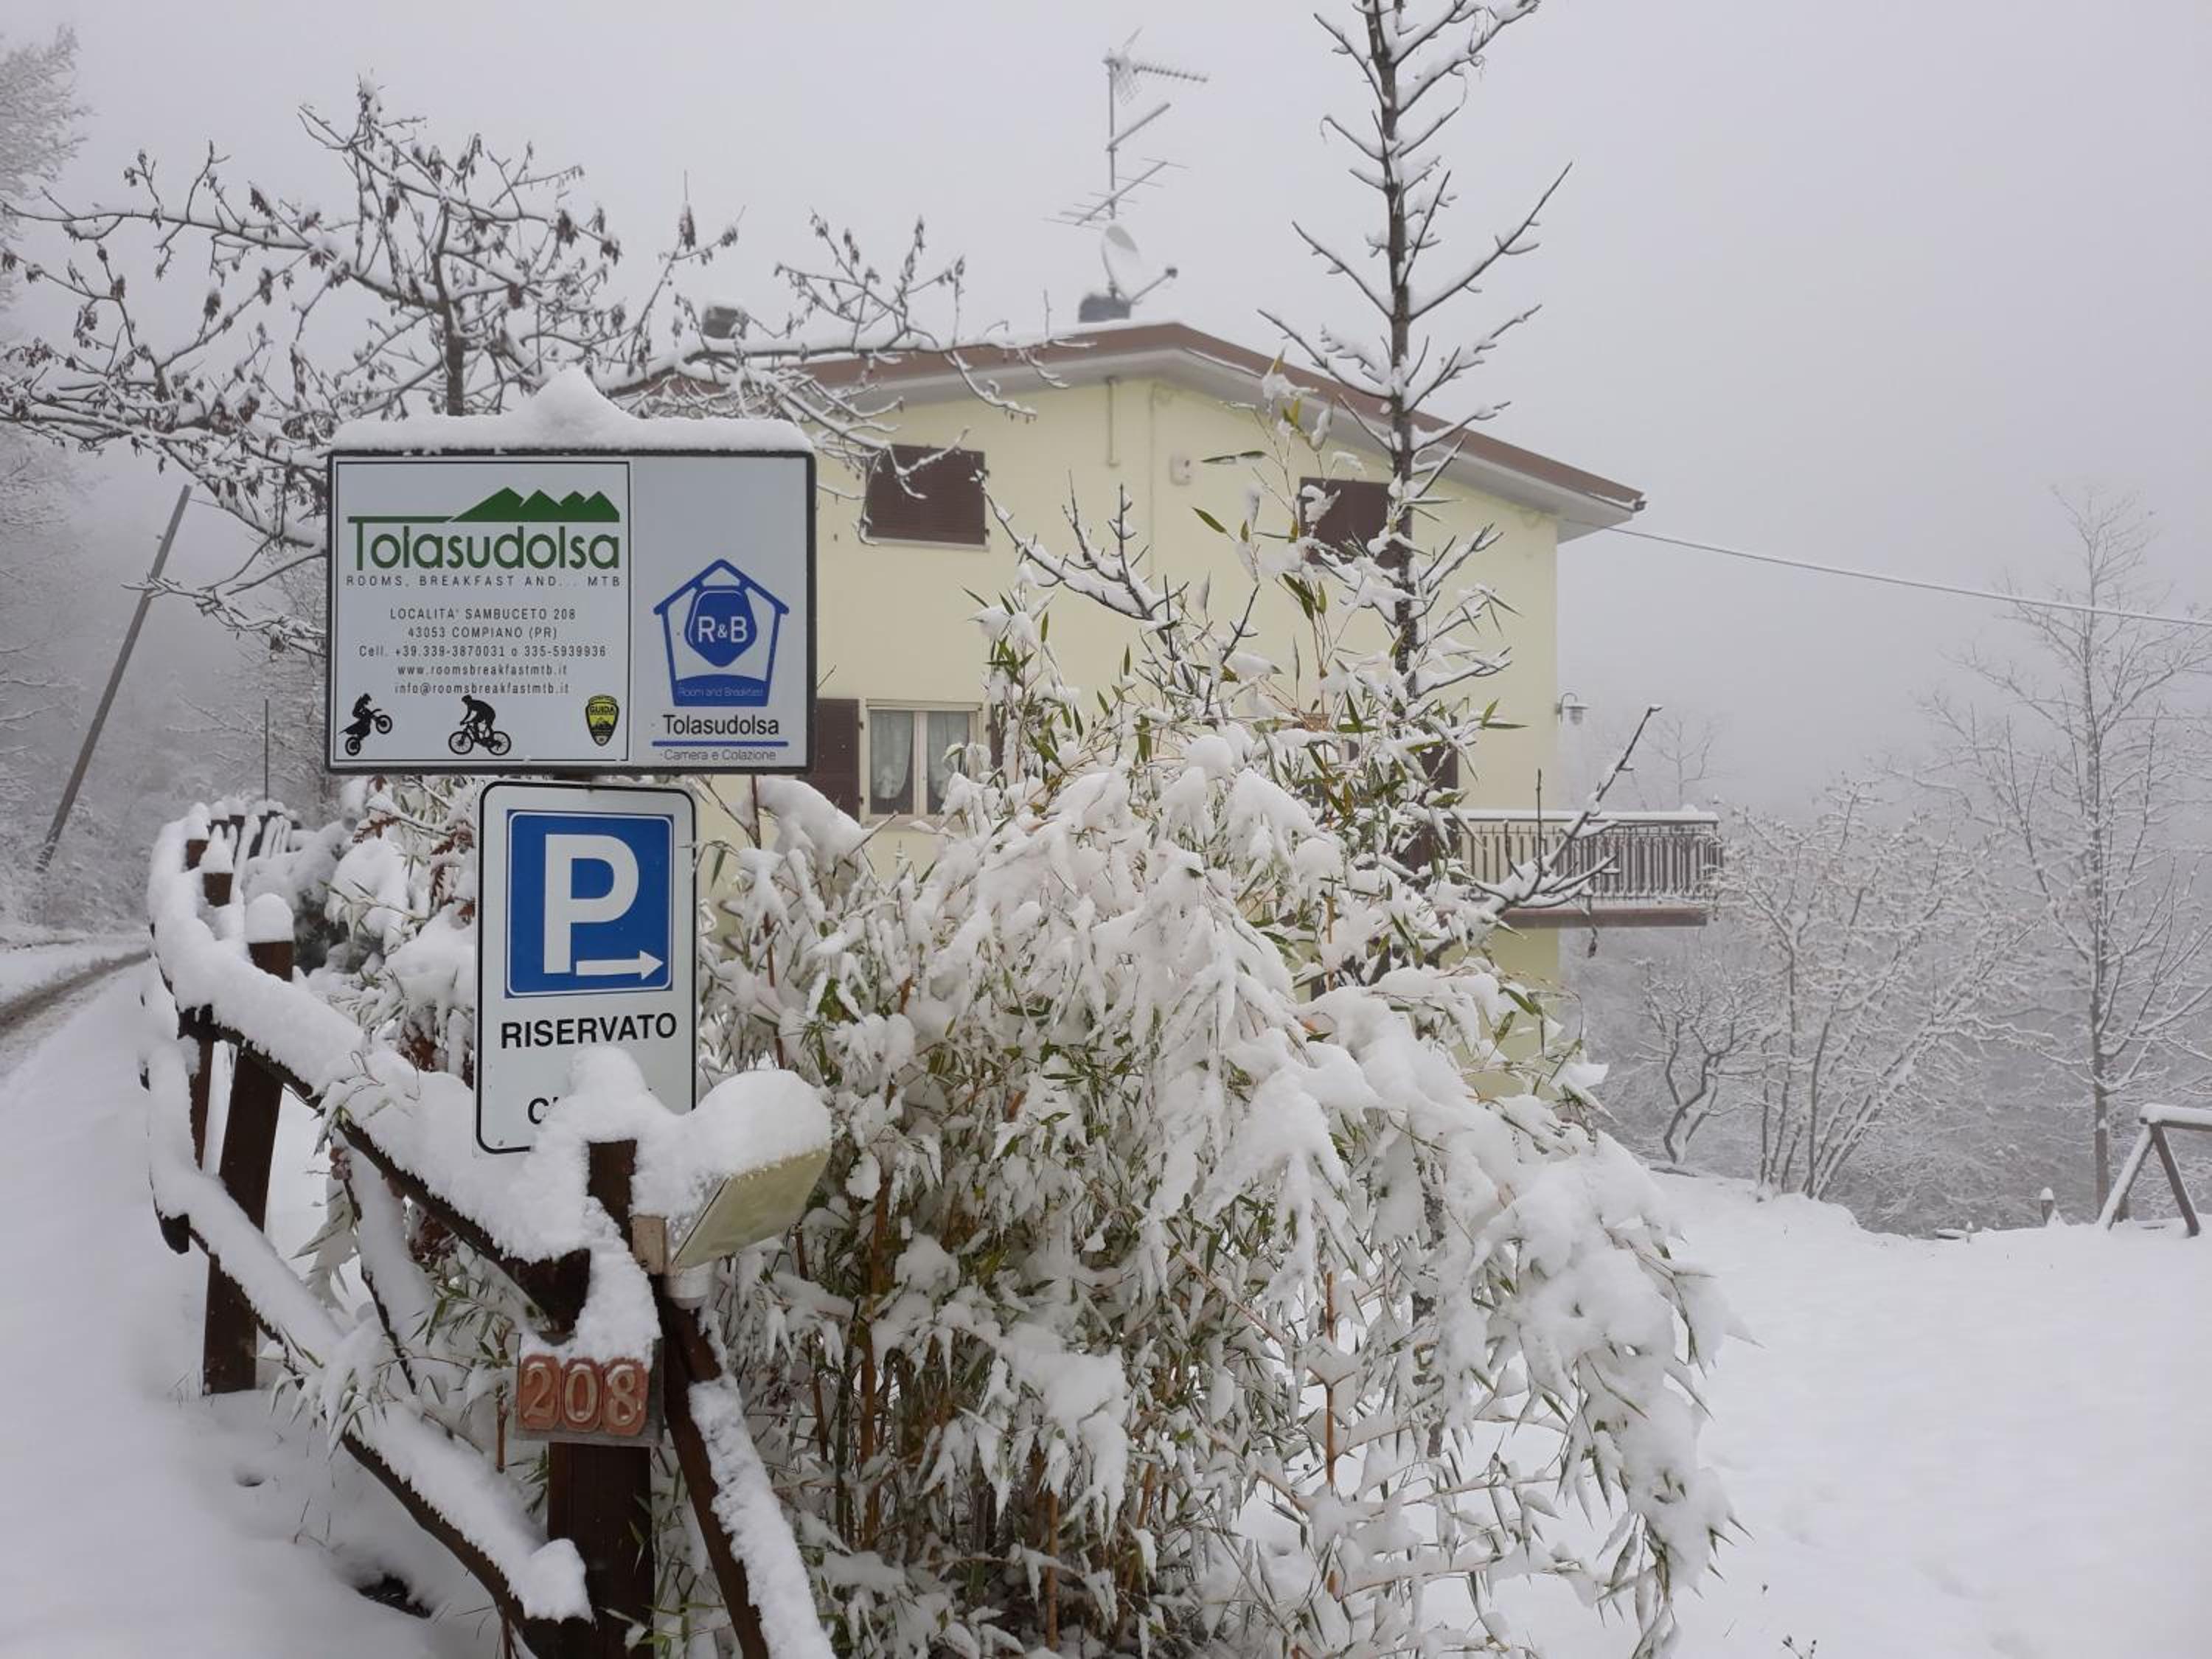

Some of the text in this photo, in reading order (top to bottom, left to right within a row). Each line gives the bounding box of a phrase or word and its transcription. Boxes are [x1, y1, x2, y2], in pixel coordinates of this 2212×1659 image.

[347, 515, 620, 571] Tolasudolsa
[419, 575, 515, 587] BREAKFAST
[587, 575, 621, 587] MTB
[465, 608, 547, 620] SAMBUCETO
[553, 608, 577, 620] 208
[408, 626, 557, 640] 43053 COMPIANO (PR)
[698, 616, 748, 642] R&B
[358, 644, 388, 657] Cell.
[397, 664, 568, 675] www.roomsbreakfastmtb.it
[394, 682, 569, 696] info@roomsbreakfastmtb.it
[661, 714, 779, 735] Tolasudolsa
[664, 748, 776, 762] Camera e Colazione
[543, 833, 640, 974] P
[501, 1012, 677, 1049] RISERVATO
[522, 1363, 637, 1427] 208
